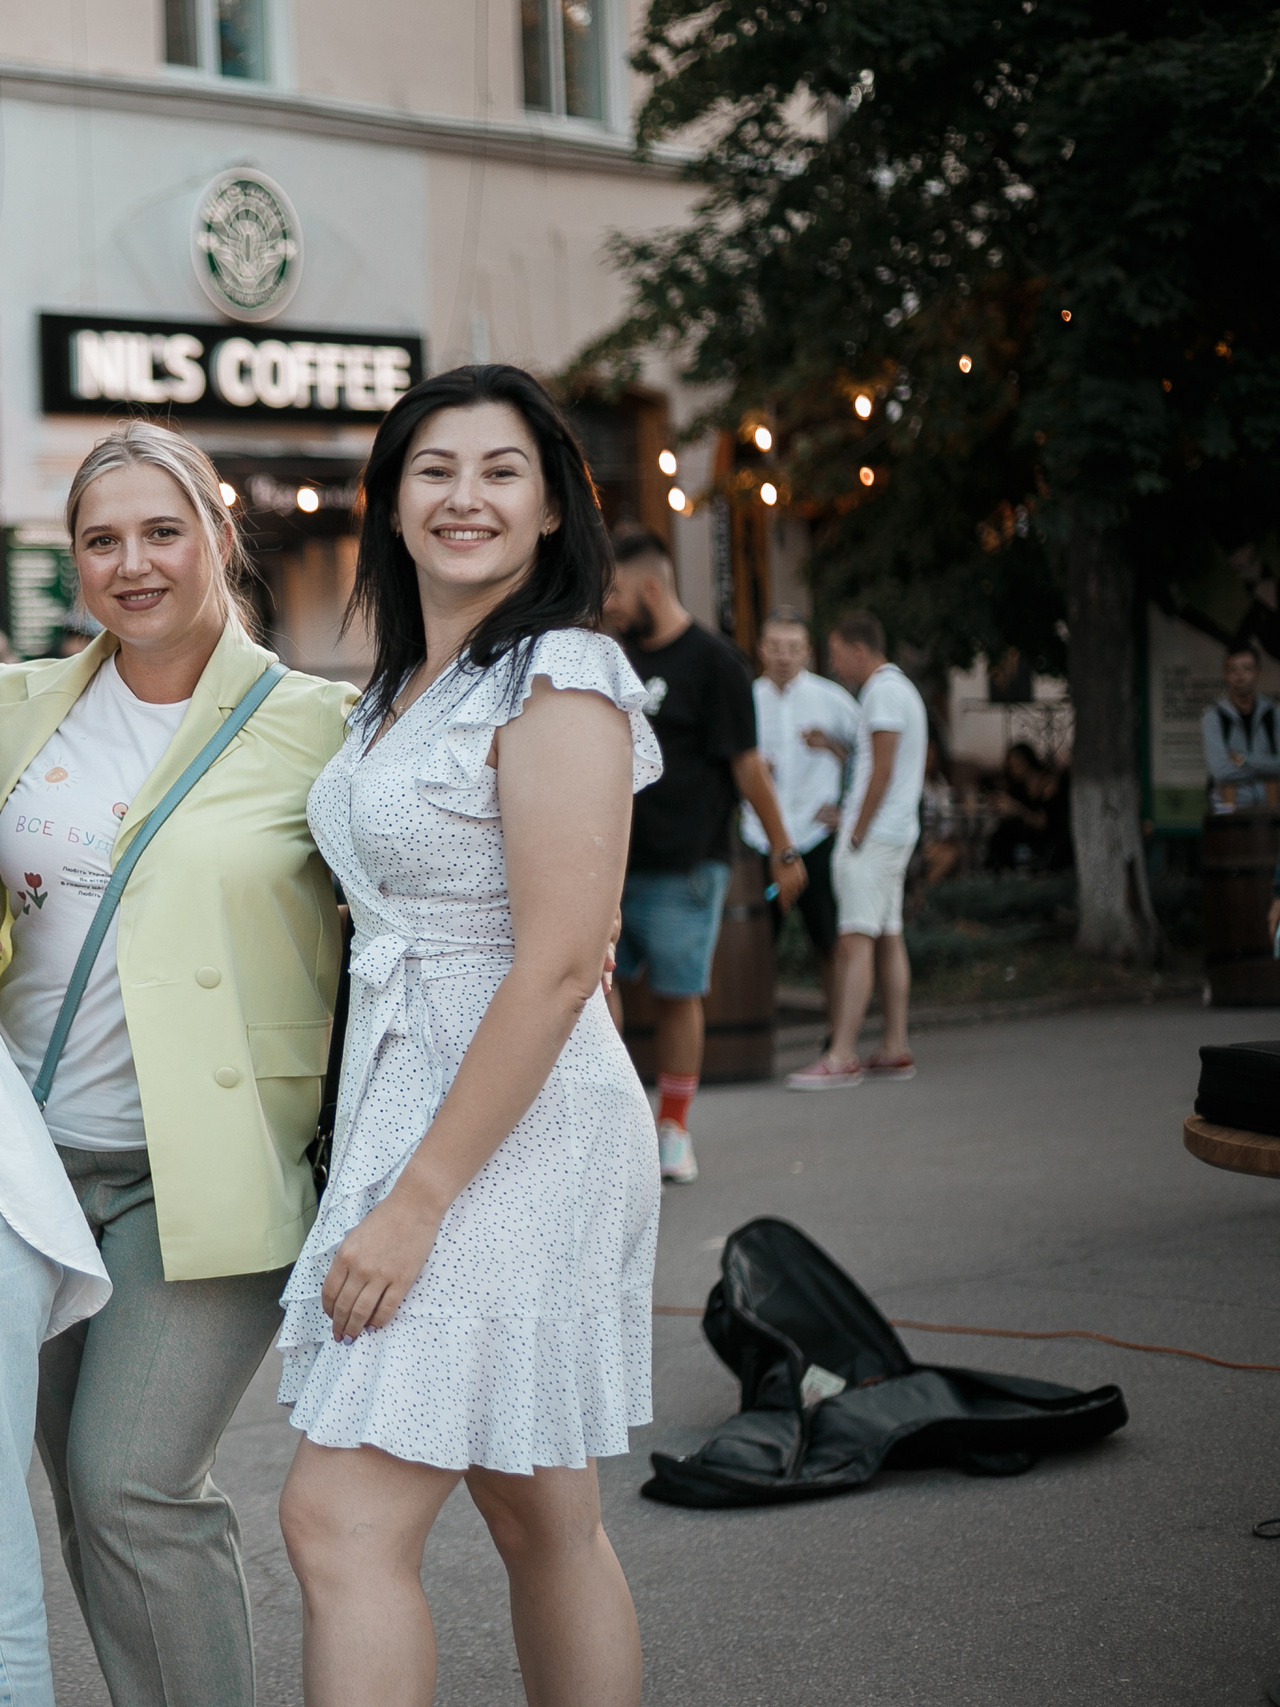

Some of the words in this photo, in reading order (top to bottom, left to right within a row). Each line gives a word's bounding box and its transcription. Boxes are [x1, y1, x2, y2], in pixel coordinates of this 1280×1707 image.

[214, 337, 411, 411] COFFEE
[16, 815, 55, 836] ВСЕ
[67, 826, 110, 854] БУД
